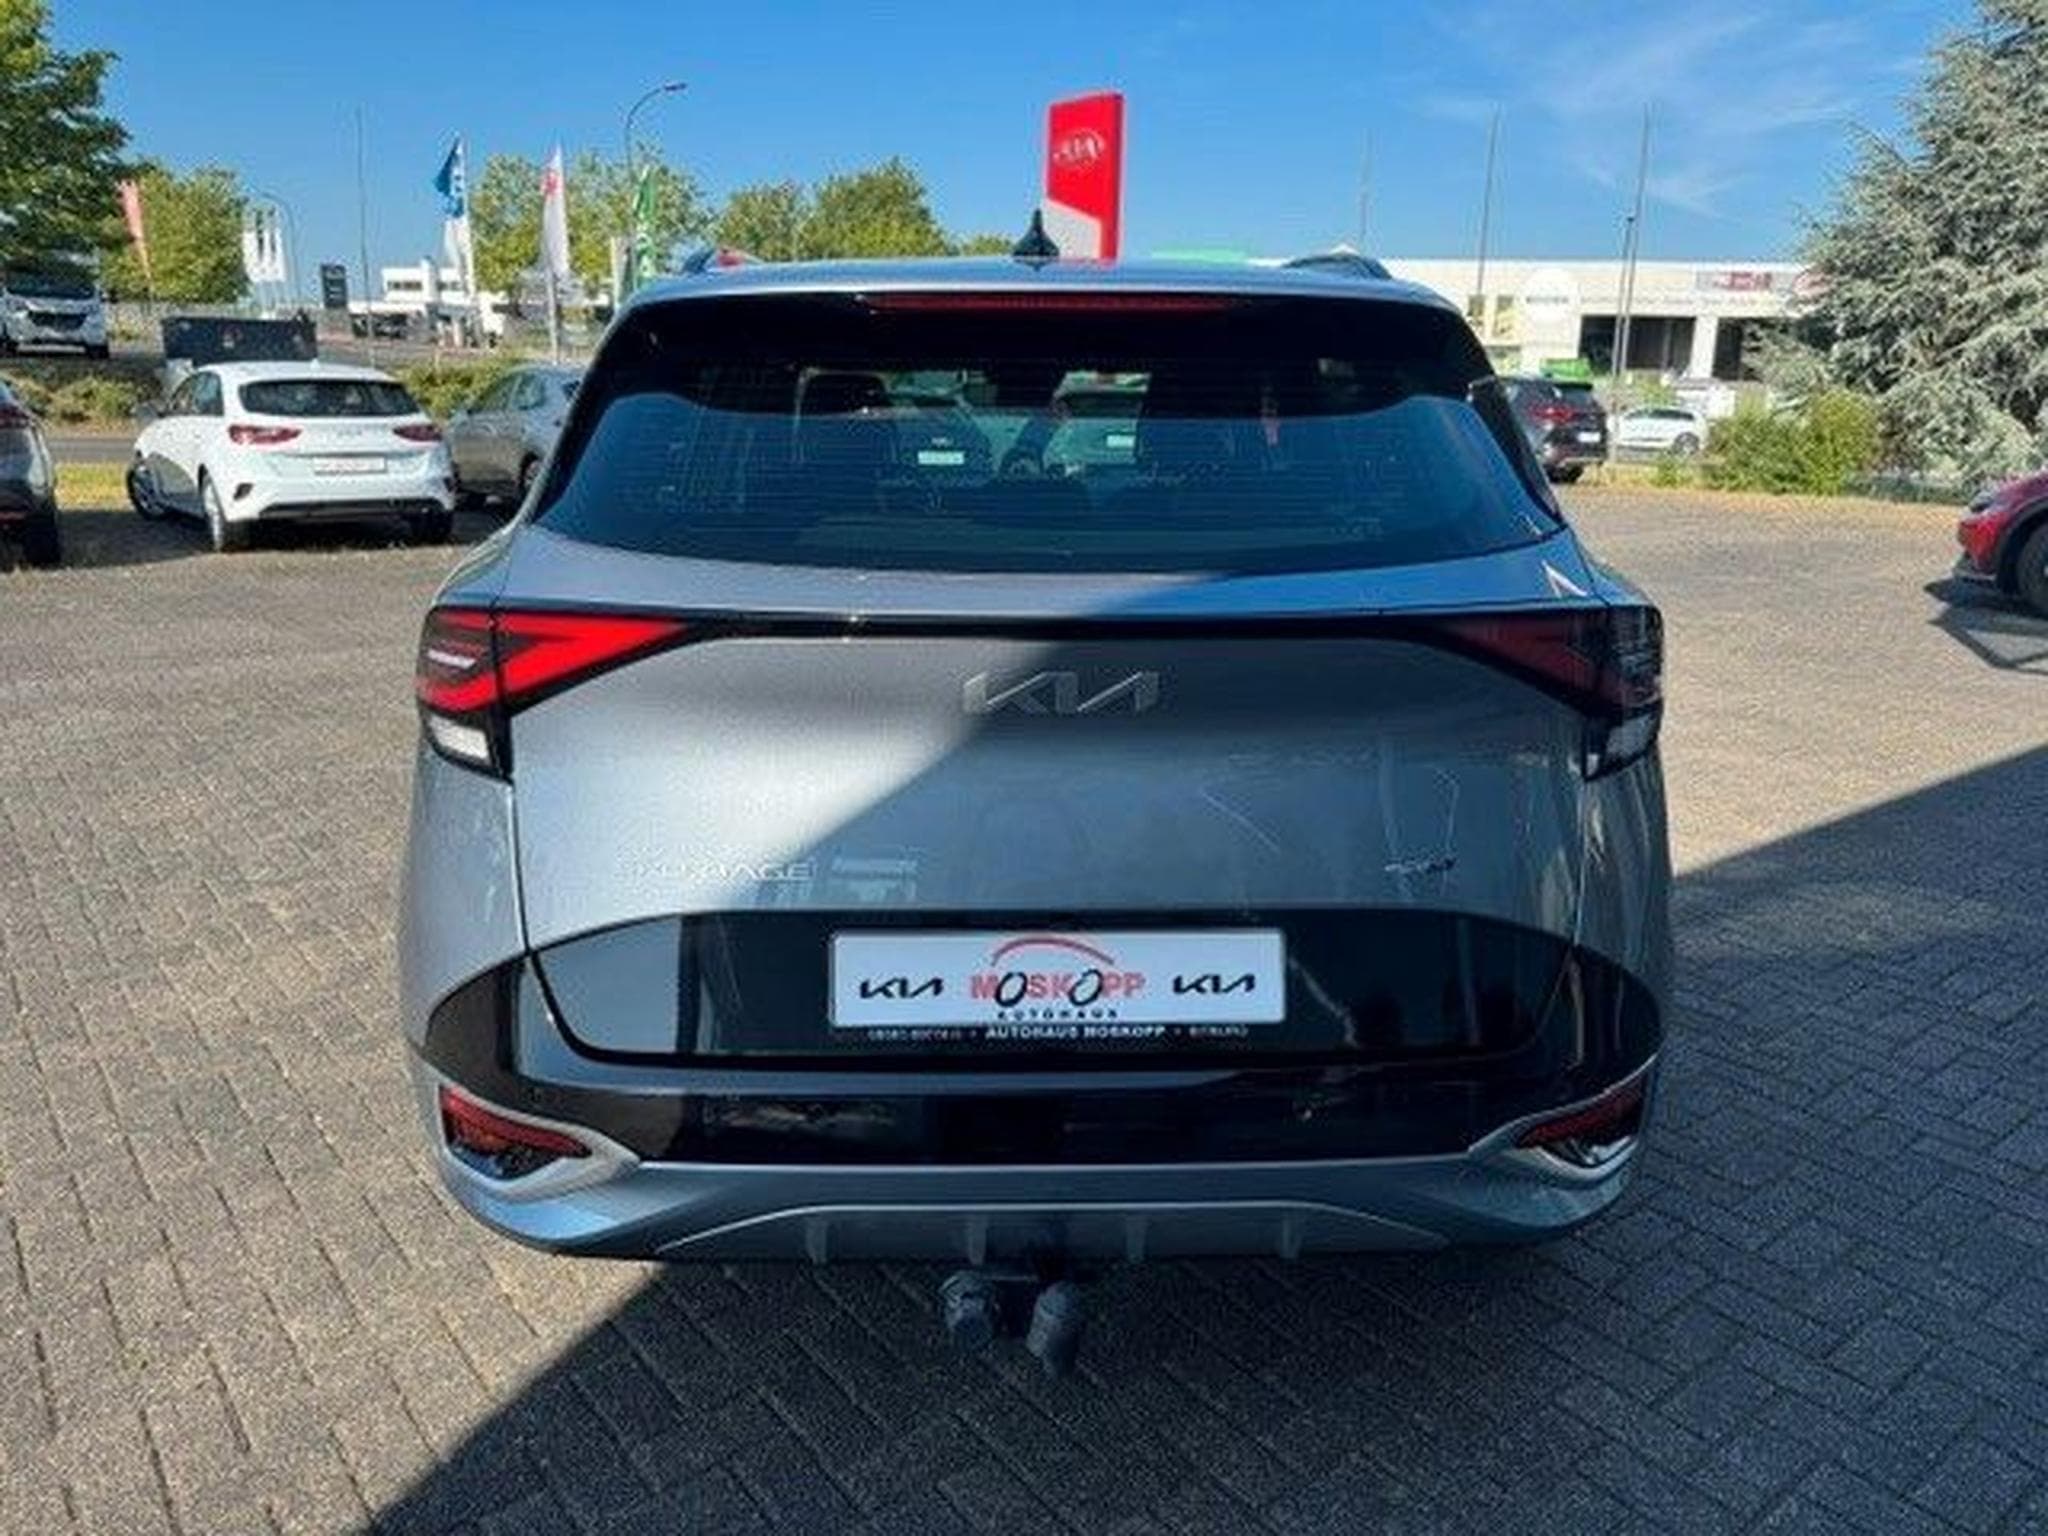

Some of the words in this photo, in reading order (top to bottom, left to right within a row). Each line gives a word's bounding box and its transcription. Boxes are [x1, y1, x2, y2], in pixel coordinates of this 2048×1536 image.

[963, 671, 1159, 713] KIA
[860, 976, 943, 999] KIA
[970, 969, 1146, 1007] MOSKOPP
[1173, 973, 1256, 994] KIA
[985, 1026, 1078, 1039] AUTOHAUS
[1084, 1025, 1166, 1038] MOSKOPP
